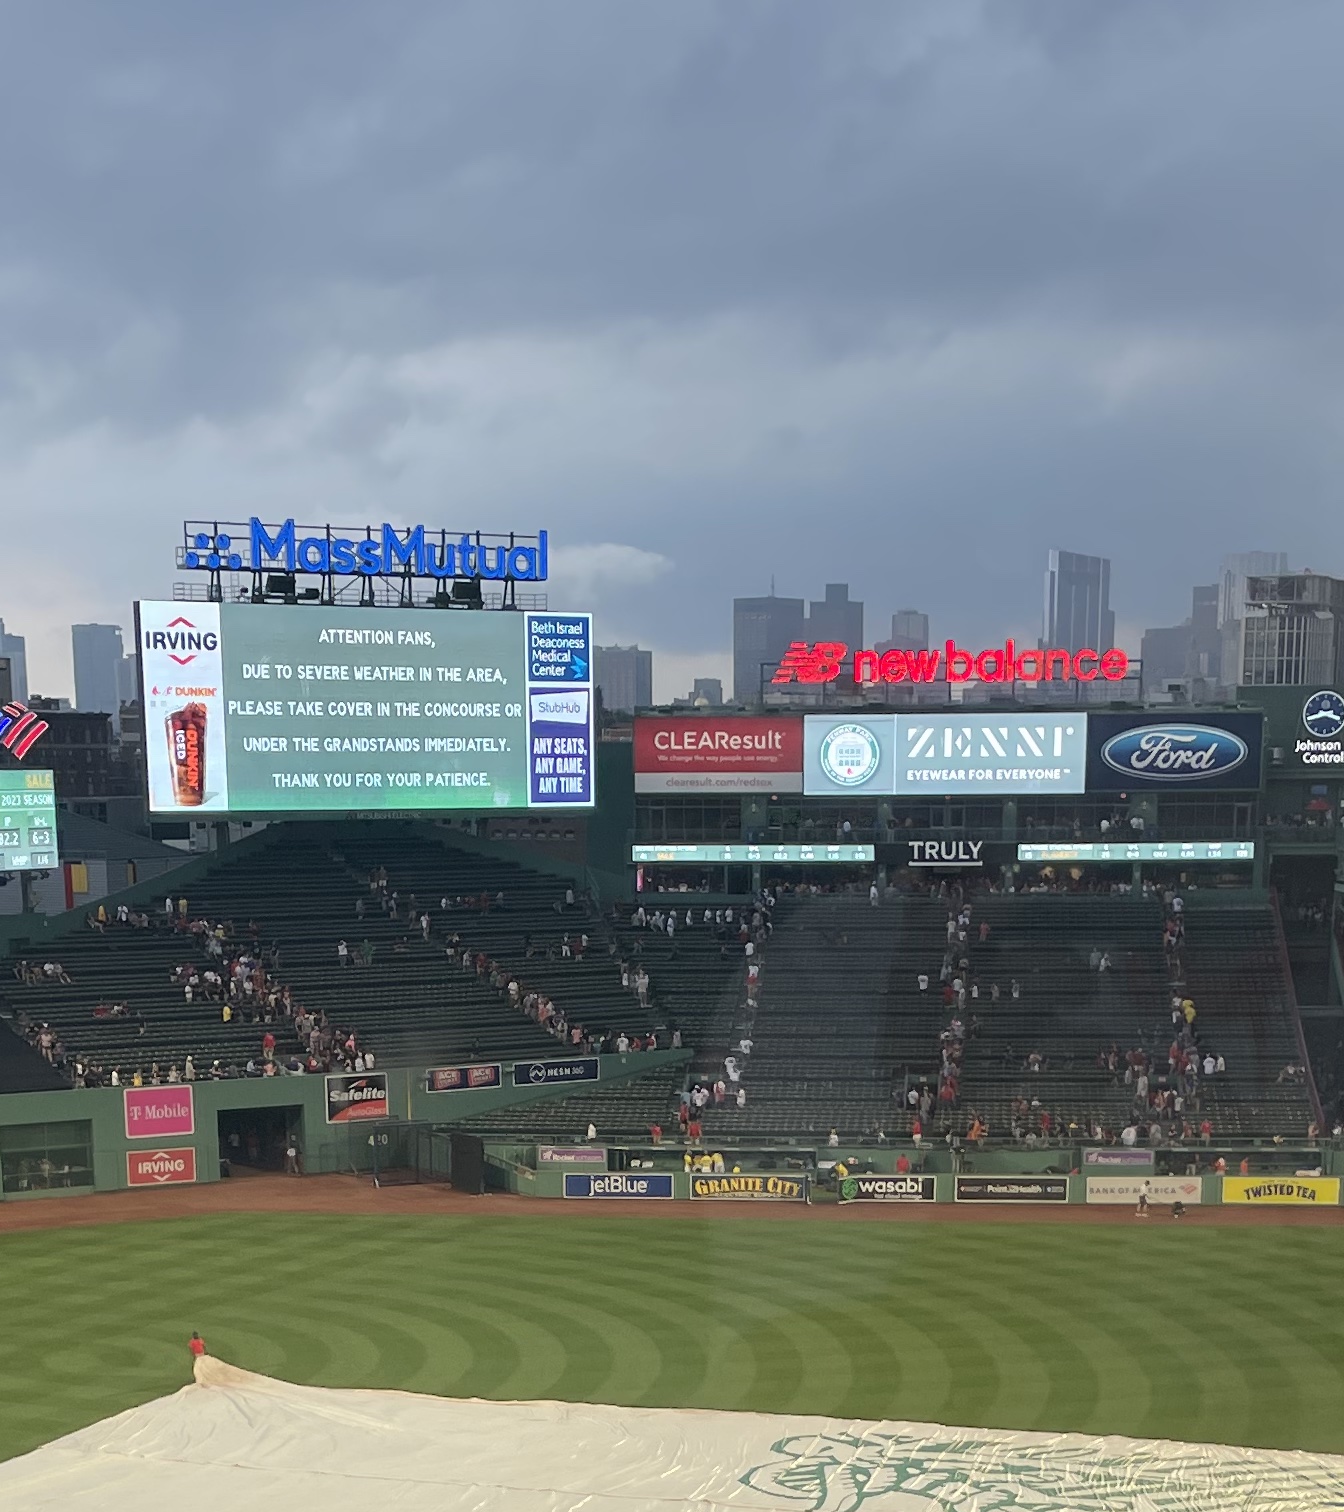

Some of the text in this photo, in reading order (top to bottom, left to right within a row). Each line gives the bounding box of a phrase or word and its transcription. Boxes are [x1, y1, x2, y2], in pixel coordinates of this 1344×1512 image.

[250, 517, 548, 581] MassMutual
[532, 621, 583, 634] Beth Israel
[145, 631, 218, 651] IRVING
[319, 629, 436, 648] ATTENTION FANS,
[532, 635, 585, 649] Deaconess
[532, 650, 571, 662] Medical
[854, 649, 941, 682] new
[946, 639, 1130, 683] balance
[242, 663, 508, 685] DUE TO SEVERE WEATHER IN THE AREA,
[532, 664, 566, 676] Center
[228, 700, 522, 718] PLEASE TAKE COVER IN THE CONCOURSE OR
[538, 702, 580, 714] StubHub
[175, 729, 186, 760] ICED
[243, 737, 511, 752] UNDER THE GRANDSTANDS IMMEDIATELY.
[534, 738, 587, 756] ANY SEATS,
[654, 730, 782, 750] CLEAResult
[907, 727, 1063, 757] ZENNI
[1295, 740, 1342, 752] Johnson
[1130, 732, 1218, 770] Ford
[535, 758, 586, 775] ANY GAME,
[907, 768, 1061, 780] EYEWEAR FOR EVERYONE
[25, 773, 52, 788] SALE
[273, 773, 491, 788] THANK YOU FOR YOUR PATIENCE.
[539, 777, 583, 793] ANY TIME
[666, 778, 773, 787] clearesult.com/redsox
[1, 792, 53, 806] 2023 SEASON
[32, 831, 50, 844] 6-3
[908, 841, 983, 860] TRULY
[547, 1067, 571, 1077] NESN
[330, 1088, 386, 1102] Safelite
[145, 1104, 189, 1120] Mobile
[346, 1106, 386, 1116] AutoGlass
[138, 1159, 185, 1174] IRVING
[589, 1175, 648, 1197] jetBlue
[695, 1176, 803, 1196] GRANITE CITY
[859, 1177, 923, 1193] wasabi
[1243, 1183, 1317, 1201] TWISTED TEA
